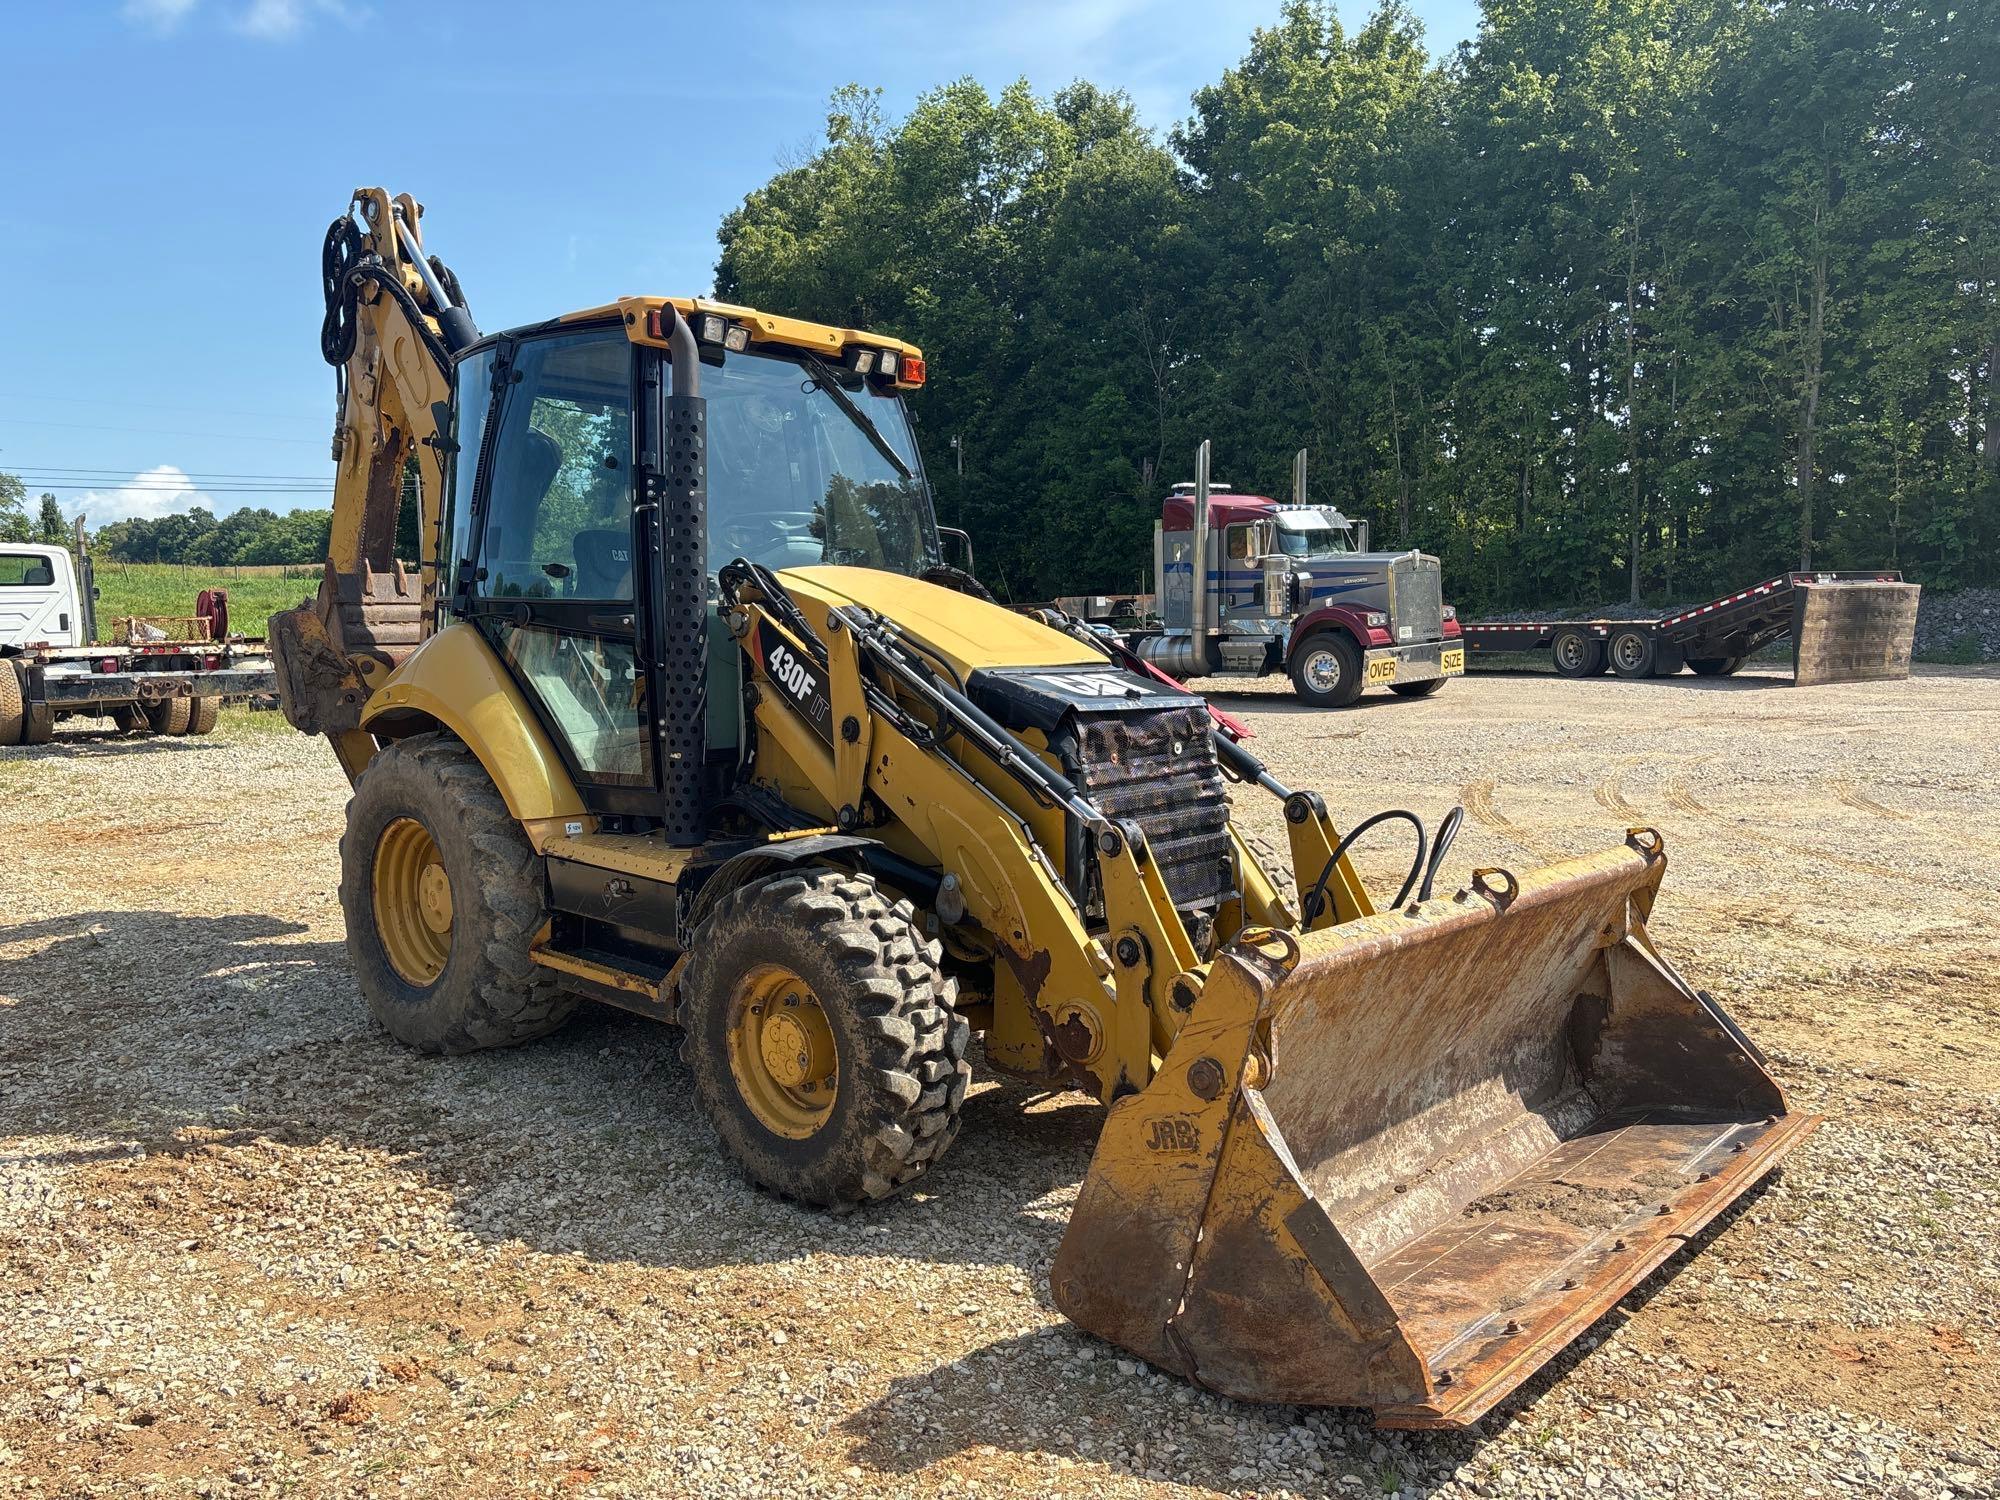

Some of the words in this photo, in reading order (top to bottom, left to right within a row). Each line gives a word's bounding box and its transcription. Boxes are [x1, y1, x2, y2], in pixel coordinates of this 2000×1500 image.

[611, 549, 629, 561] CAT
[1369, 661, 1396, 679] OVER
[1443, 652, 1462, 670] SIZE
[769, 644, 817, 701] 430F
[810, 693, 831, 722] IT
[1032, 673, 1157, 697] CAT
